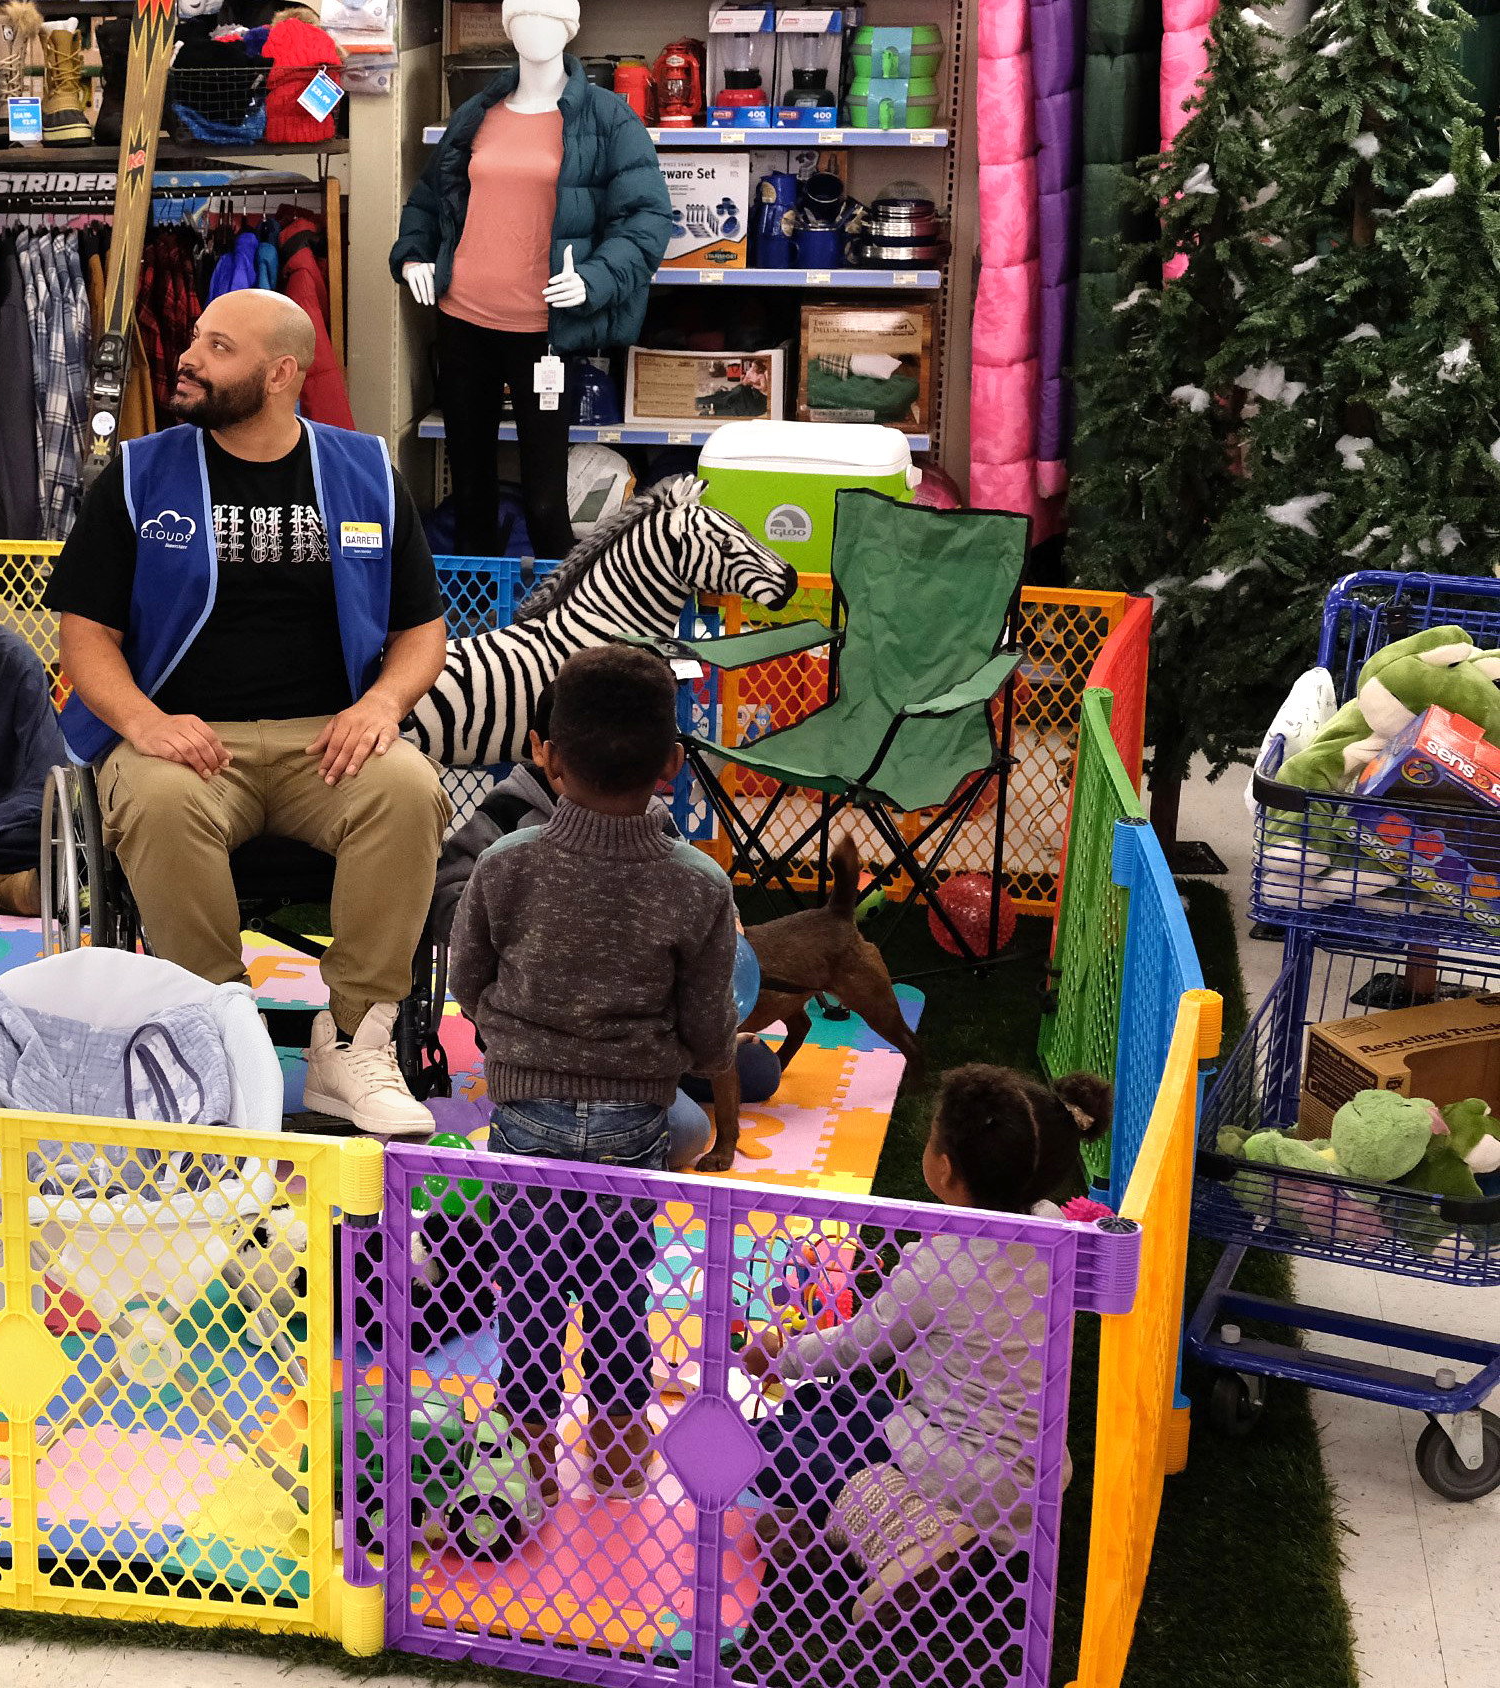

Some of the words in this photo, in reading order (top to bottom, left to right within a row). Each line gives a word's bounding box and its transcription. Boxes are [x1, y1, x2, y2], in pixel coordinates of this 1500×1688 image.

[747, 110, 767, 119] 400
[813, 111, 832, 119] 400
[661, 168, 694, 180] eware
[697, 168, 717, 179] Set
[141, 528, 192, 543] CLOUD9
[345, 535, 380, 546] GARRETT
[1357, 1031, 1452, 1054] Recycling
